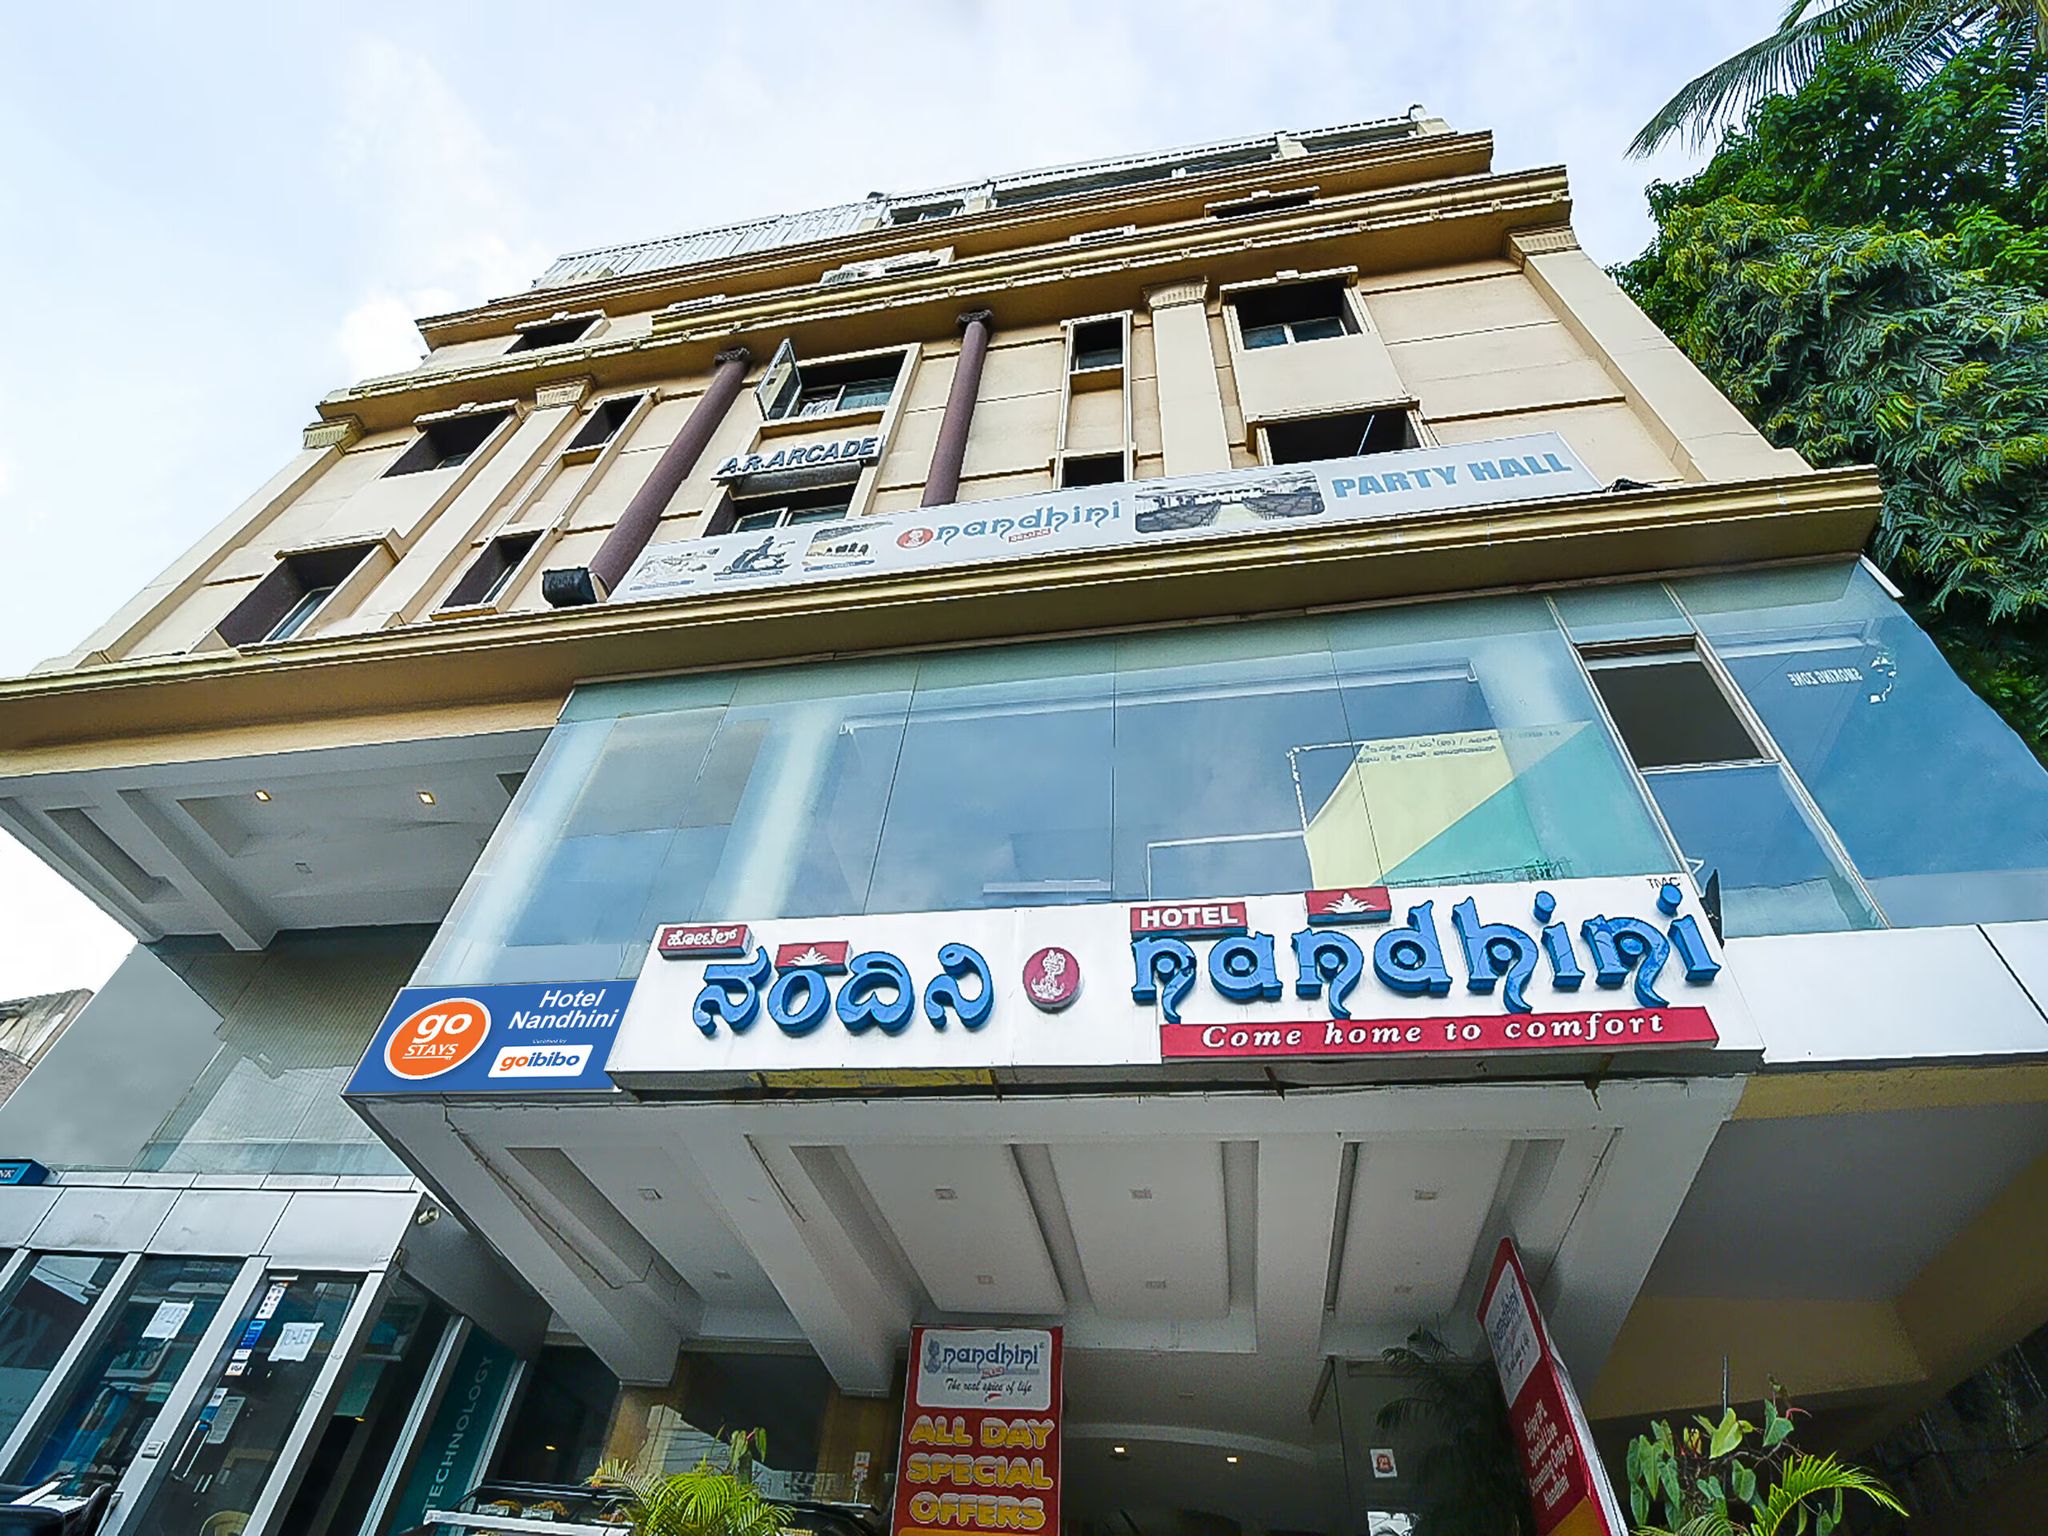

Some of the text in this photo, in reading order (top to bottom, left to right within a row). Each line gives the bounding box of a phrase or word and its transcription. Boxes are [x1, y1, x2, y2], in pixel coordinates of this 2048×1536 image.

[1332, 453, 1573, 498] PARTY HALL
[934, 500, 1121, 545] nandhini
[1140, 905, 1239, 929] HOTEL
[1131, 883, 1722, 1025] nandhini
[539, 988, 607, 1009] Hotel
[693, 942, 994, 1038] ನಂದಿನಿ
[412, 1012, 473, 1044] go
[508, 1009, 620, 1030] Nandhini
[1201, 1012, 1664, 1048] Come home to comfort
[405, 1043, 458, 1056] STAYS
[500, 1051, 580, 1072] goibibo
[942, 1342, 1039, 1371] nandhini
[945, 1378, 1032, 1397] The real spice of life
[422, 1355, 494, 1514] TECHNOLOGY
[908, 1415, 1055, 1449] ALL DAY
[906, 1453, 1054, 1490] SPECIAL
[909, 1491, 1046, 1531] OFFERS
